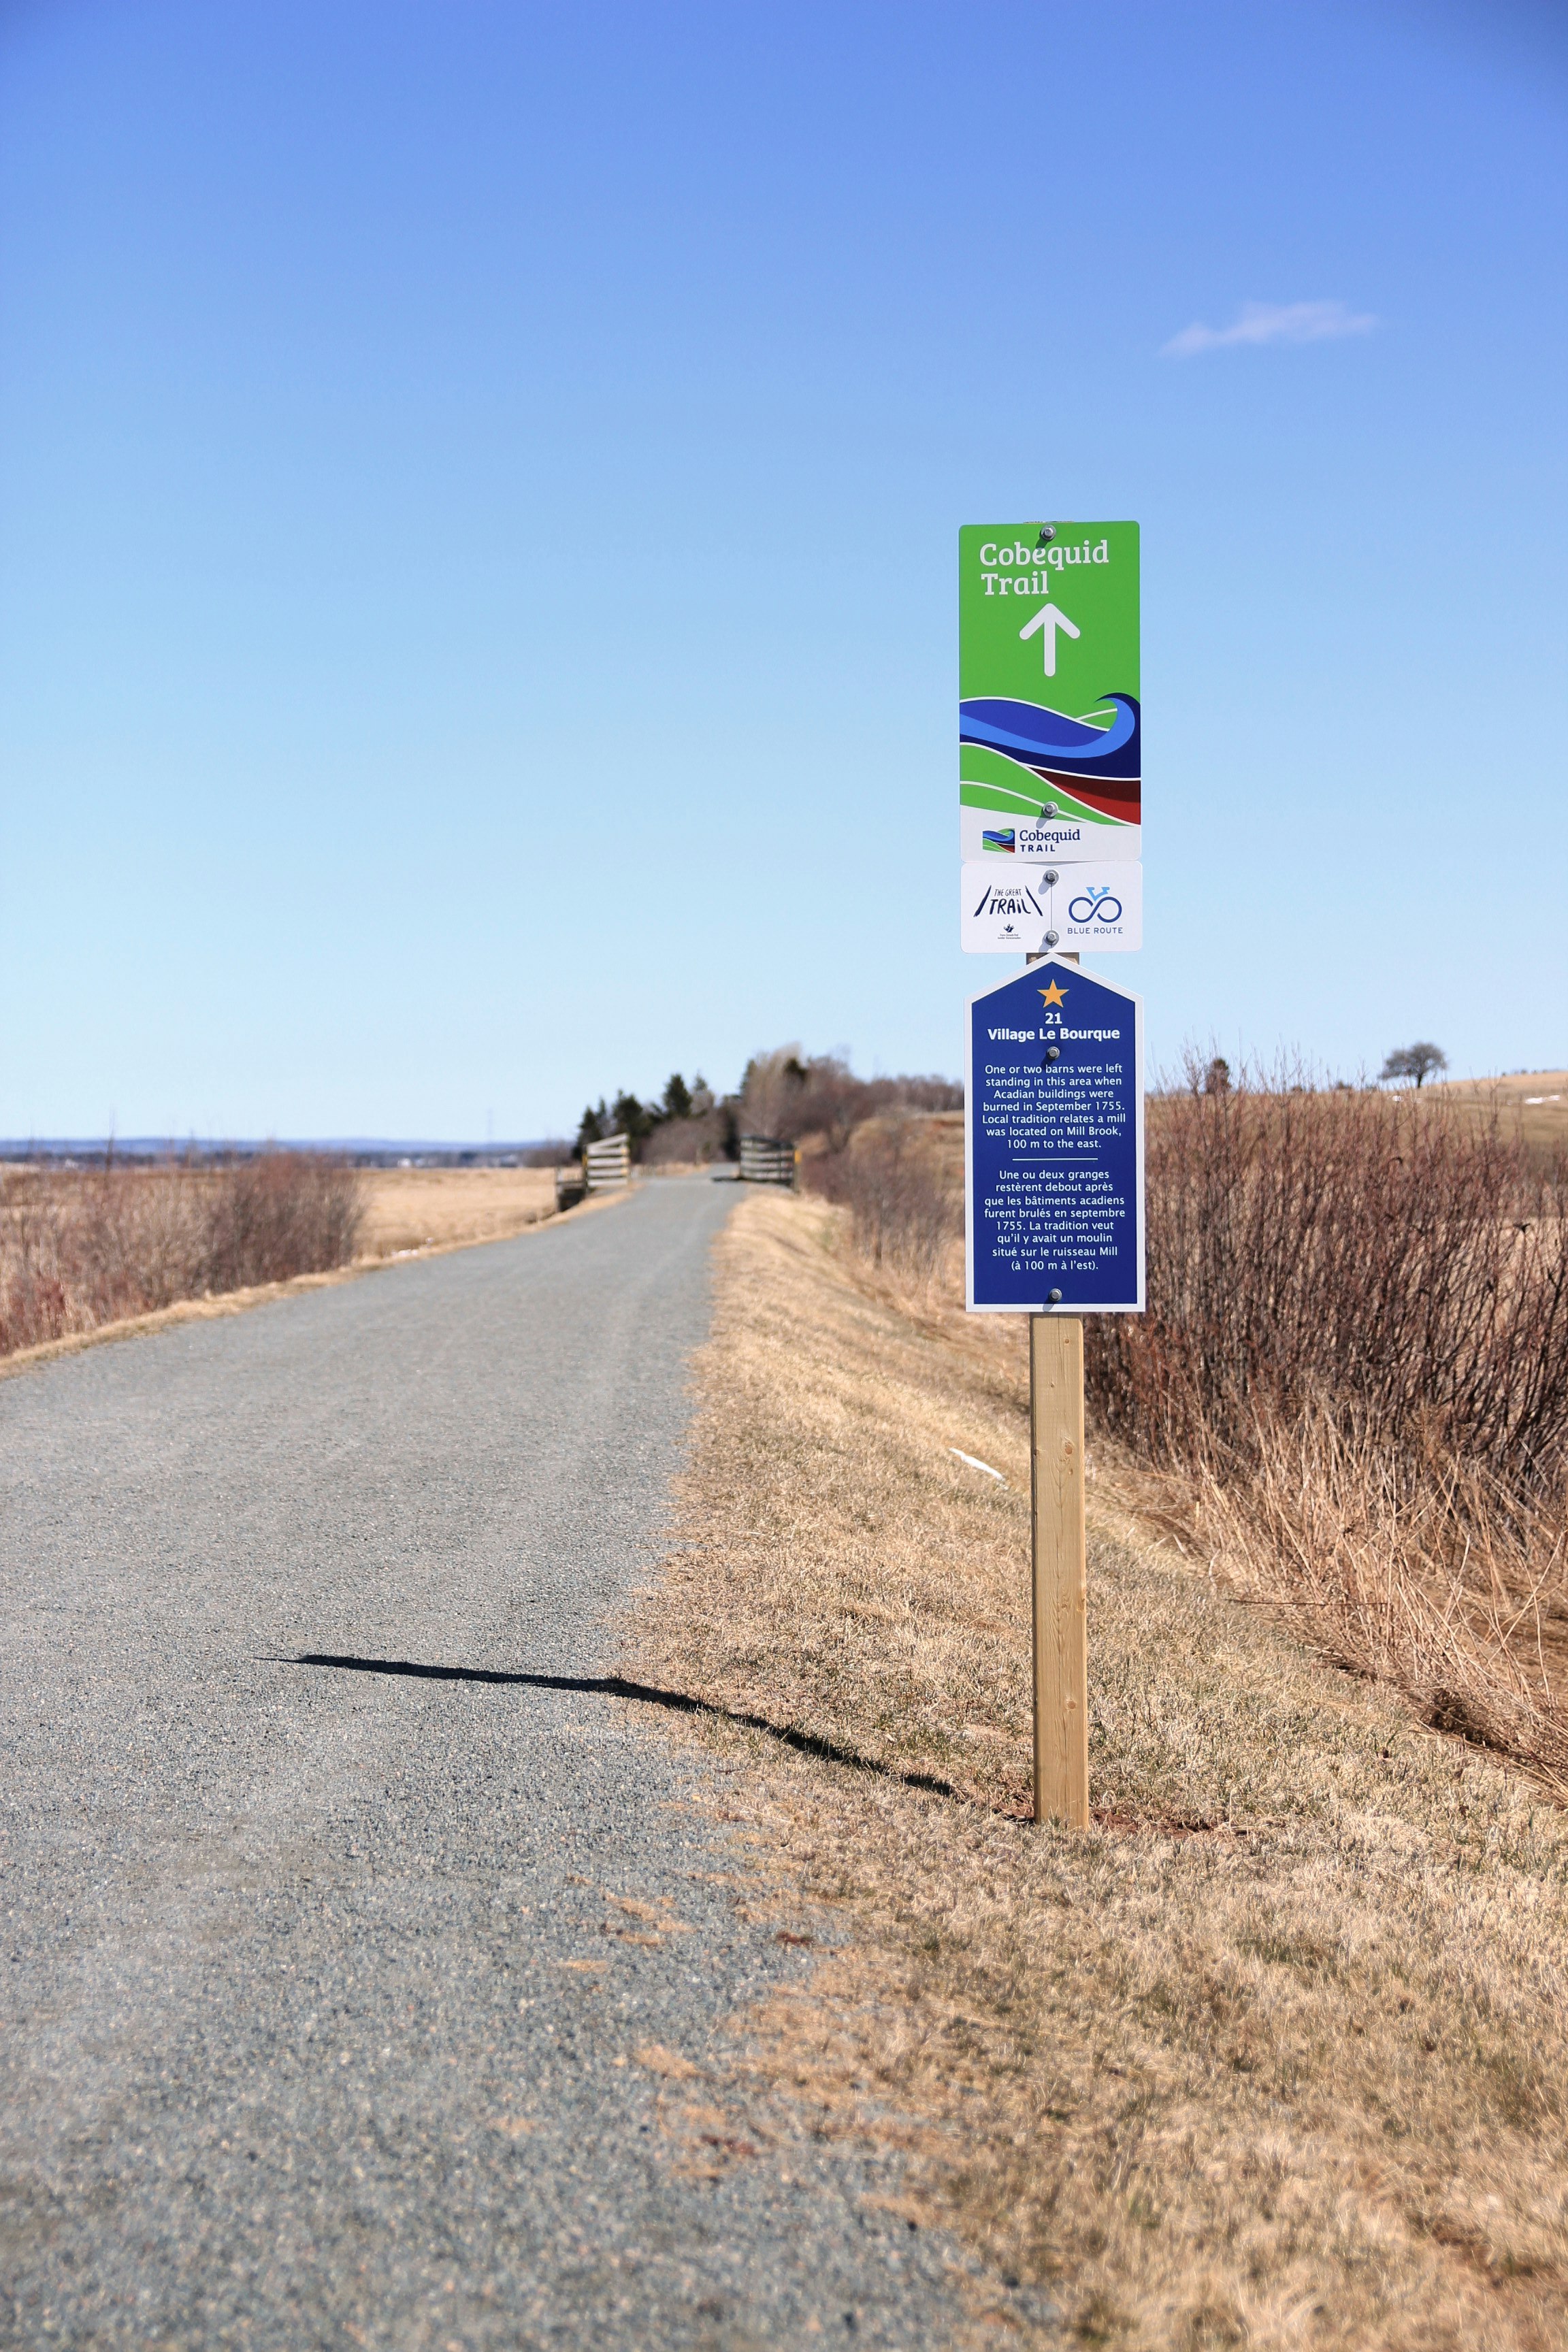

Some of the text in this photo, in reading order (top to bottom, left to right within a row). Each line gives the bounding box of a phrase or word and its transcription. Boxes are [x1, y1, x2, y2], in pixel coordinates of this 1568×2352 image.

[980, 540, 1109, 570] Cobequid
[981, 571, 1049, 595] Trail
[1019, 830, 1080, 843] Cobequid
[1045, 1013, 1062, 1024] 21
[987, 1028, 1120, 1042] Village Le Bourque
[985, 1066, 1006, 1074] One
[1045, 1065, 1074, 1073] barns
[1106, 1064, 1122, 1073] left
[986, 1078, 1030, 1088] standing
[1034, 1078, 1043, 1086] in
[1047, 1077, 1066, 1086] this
[994, 1090, 1034, 1098] Acadian
[1039, 1090, 1085, 1100] buildings
[983, 1101, 1124, 1113] burned in September 1755.
[983, 1114, 1008, 1124] Local
[1012, 1114, 1056, 1124] tradition
[1060, 1114, 1094, 1123] relates
[1107, 1113, 1126, 1123] mill
[1010, 1127, 1046, 1136] located
[1067, 1126, 1085, 1135] Mill
[1089, 1126, 1121, 1137] Brook,
[1008, 1139, 1026, 1148] 100
[1043, 1140, 1054, 1148] to
[1057, 1139, 1073, 1148] the
[1000, 1171, 1019, 1179] Une
[1039, 1170, 1064, 1179] deux
[1068, 1171, 1109, 1181] granges
[996, 1182, 1113, 1193] restèrent debout après
[985, 1196, 1124, 1207] que les bâtiments acadiens
[984, 1209, 1015, 1218] furent
[1019, 1208, 1050, 1217] brulés
[1071, 1208, 1125, 1219] septembre
[996, 1222, 1025, 1230] 1755.
[1030, 1222, 1041, 1230] La
[1044, 1221, 1088, 1230] tradition
[1023, 1235, 1029, 1244] y
[1032, 1234, 1057, 1243] avait
[1077, 1233, 1112, 1242] moulin
[992, 1247, 1017, 1256] situé
[1041, 1247, 1049, 1256] le
[1053, 1247, 1096, 1256] ruisseau
[1100, 1247, 1117, 1256] Mill
[1011, 1261, 1021, 1270] (à
[1025, 1261, 1044, 1270] 100
[1061, 1260, 1067, 1269] à
